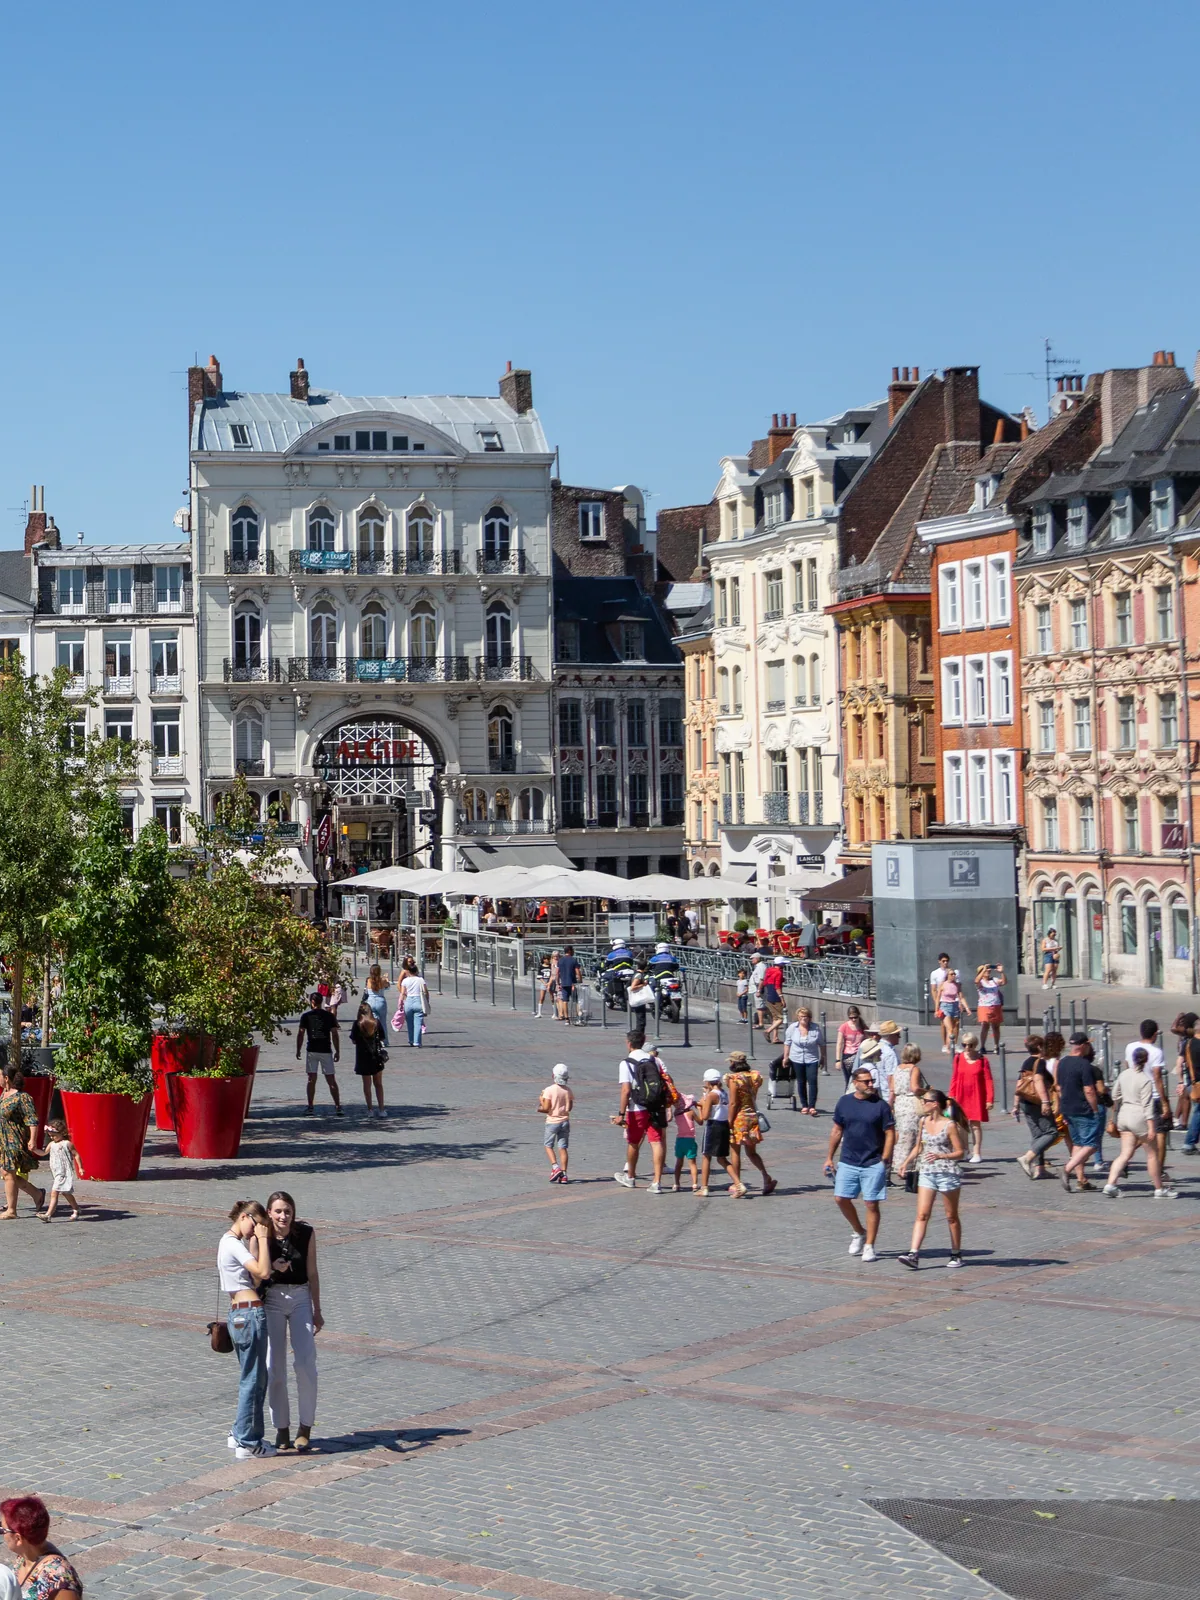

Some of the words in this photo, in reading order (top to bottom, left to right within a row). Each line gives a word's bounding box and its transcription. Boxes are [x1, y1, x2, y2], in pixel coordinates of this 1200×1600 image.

[336, 738, 420, 760] ALCIDE
[319, 823, 328, 845] TABAC
[888, 860, 895, 880] P
[953, 860, 969, 880] P
